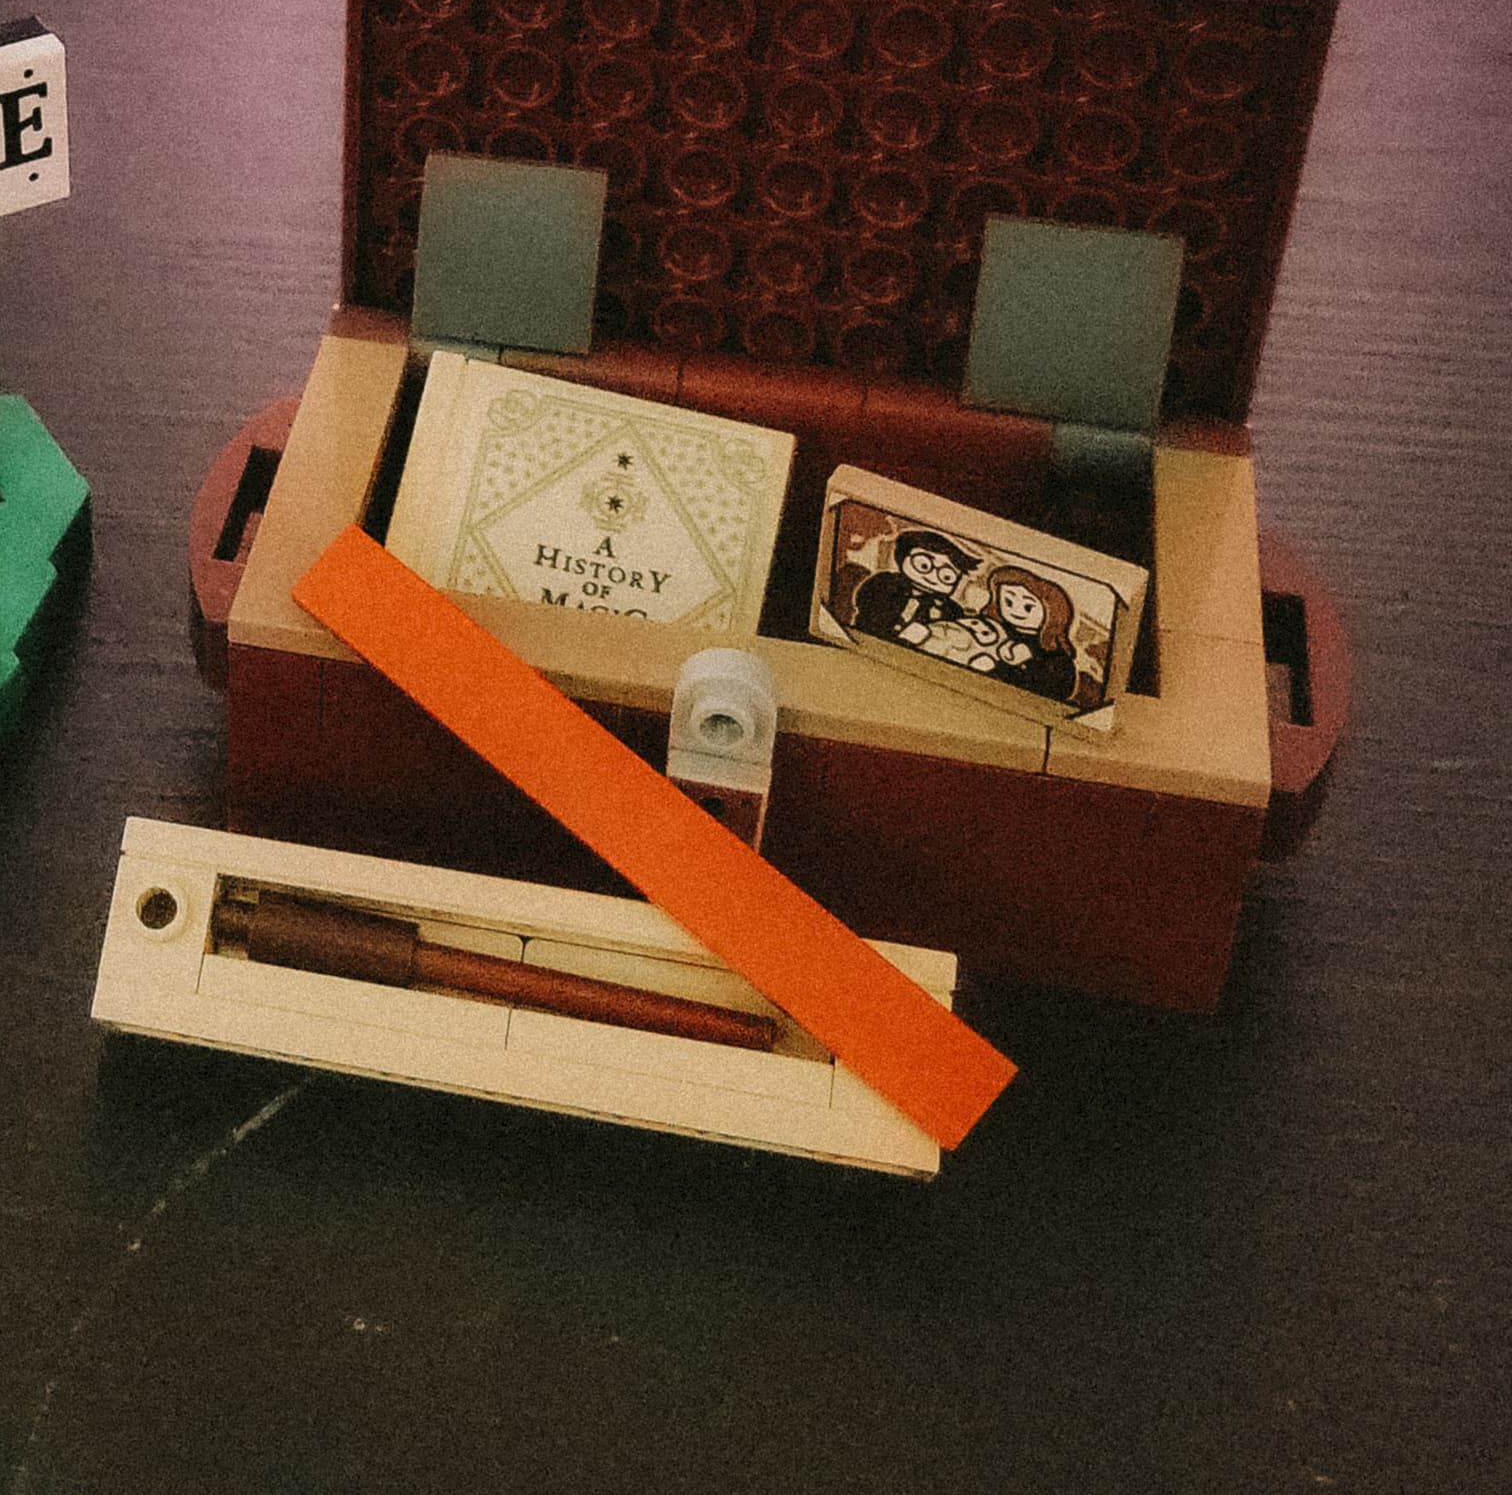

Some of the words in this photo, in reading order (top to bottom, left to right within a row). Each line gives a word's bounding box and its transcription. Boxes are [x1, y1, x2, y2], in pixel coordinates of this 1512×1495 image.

[592, 535, 617, 559] A
[533, 543, 673, 594] HISTORY
[581, 581, 613, 600] OF
